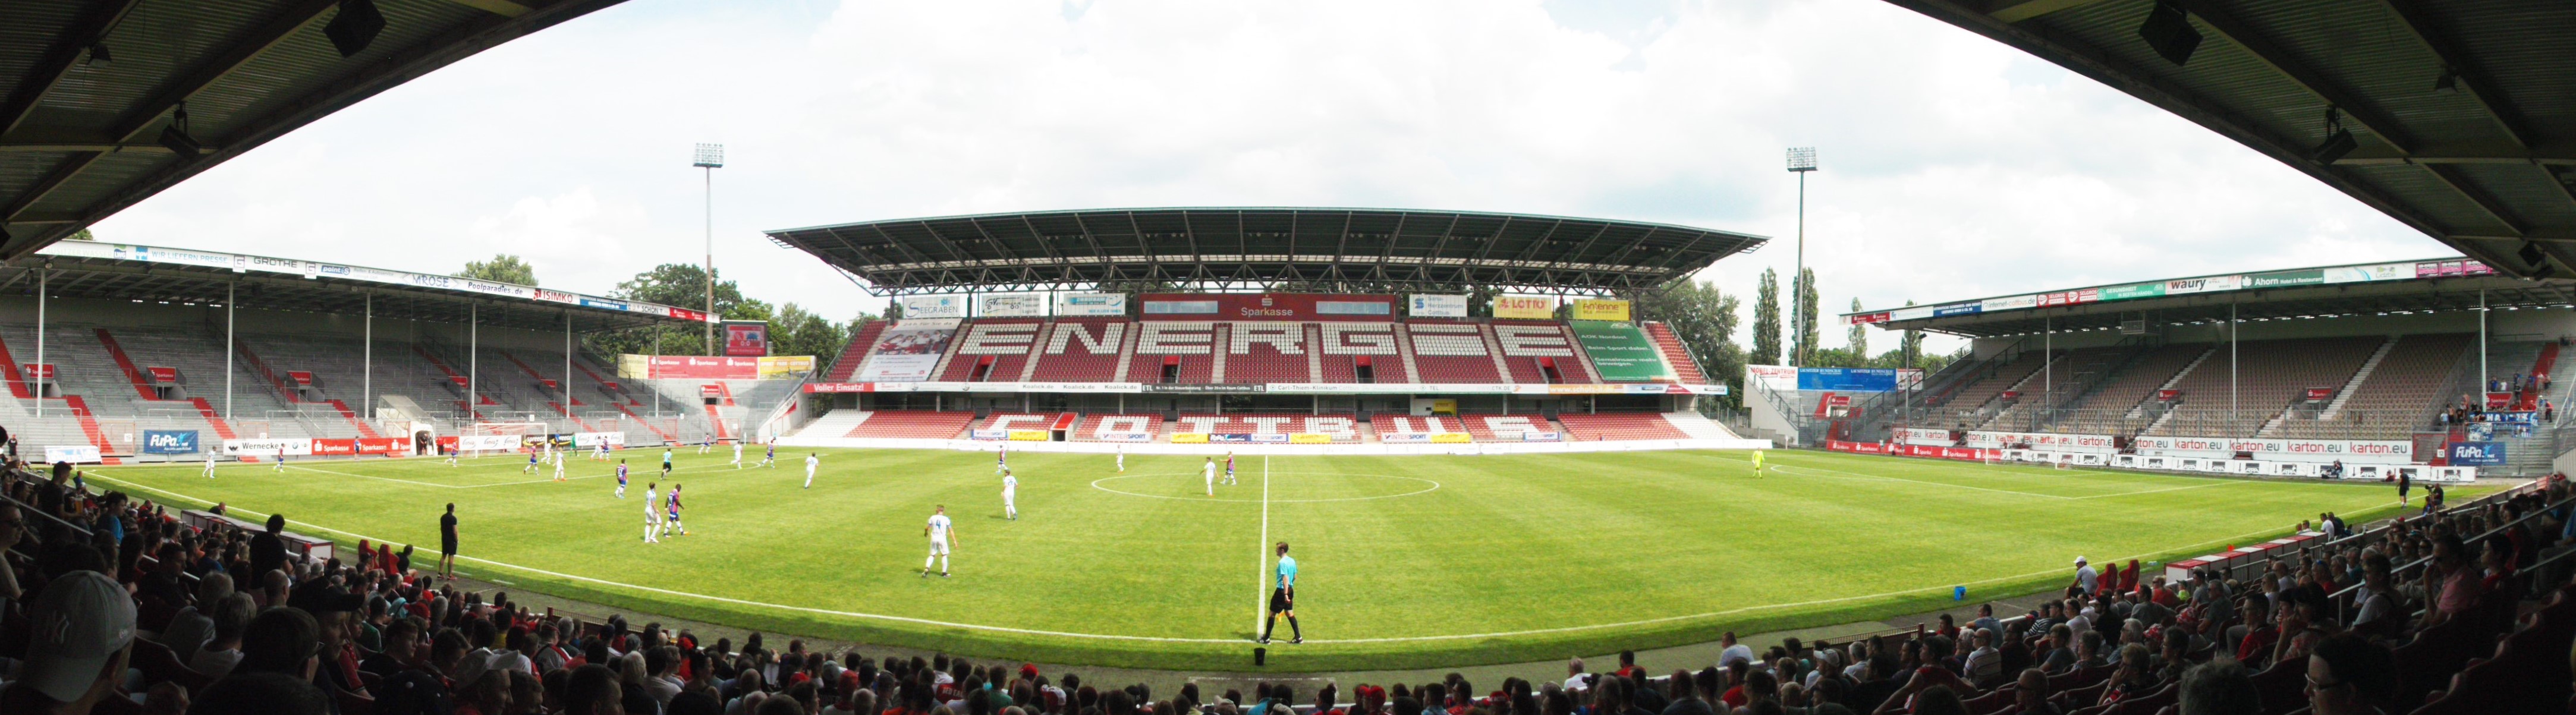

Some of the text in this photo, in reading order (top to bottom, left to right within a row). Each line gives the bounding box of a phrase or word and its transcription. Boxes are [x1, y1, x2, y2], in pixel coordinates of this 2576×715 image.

[168, 252, 198, 261] LIEFERN
[200, 254, 228, 263] PRESSE
[254, 257, 297, 267] GROTHE
[2171, 279, 2206, 291] waury
[543, 291, 573, 304] ISIMKO
[1512, 299, 1545, 308] LOTTO
[1241, 308, 1293, 318] Sparkasse
[836, 383, 864, 391] Einsatz!
[2175, 439, 2222, 450] karton.eu
[2229, 439, 2407, 453] karton.eu karton.eu karton.eu
[936, 519, 941, 530] 4
